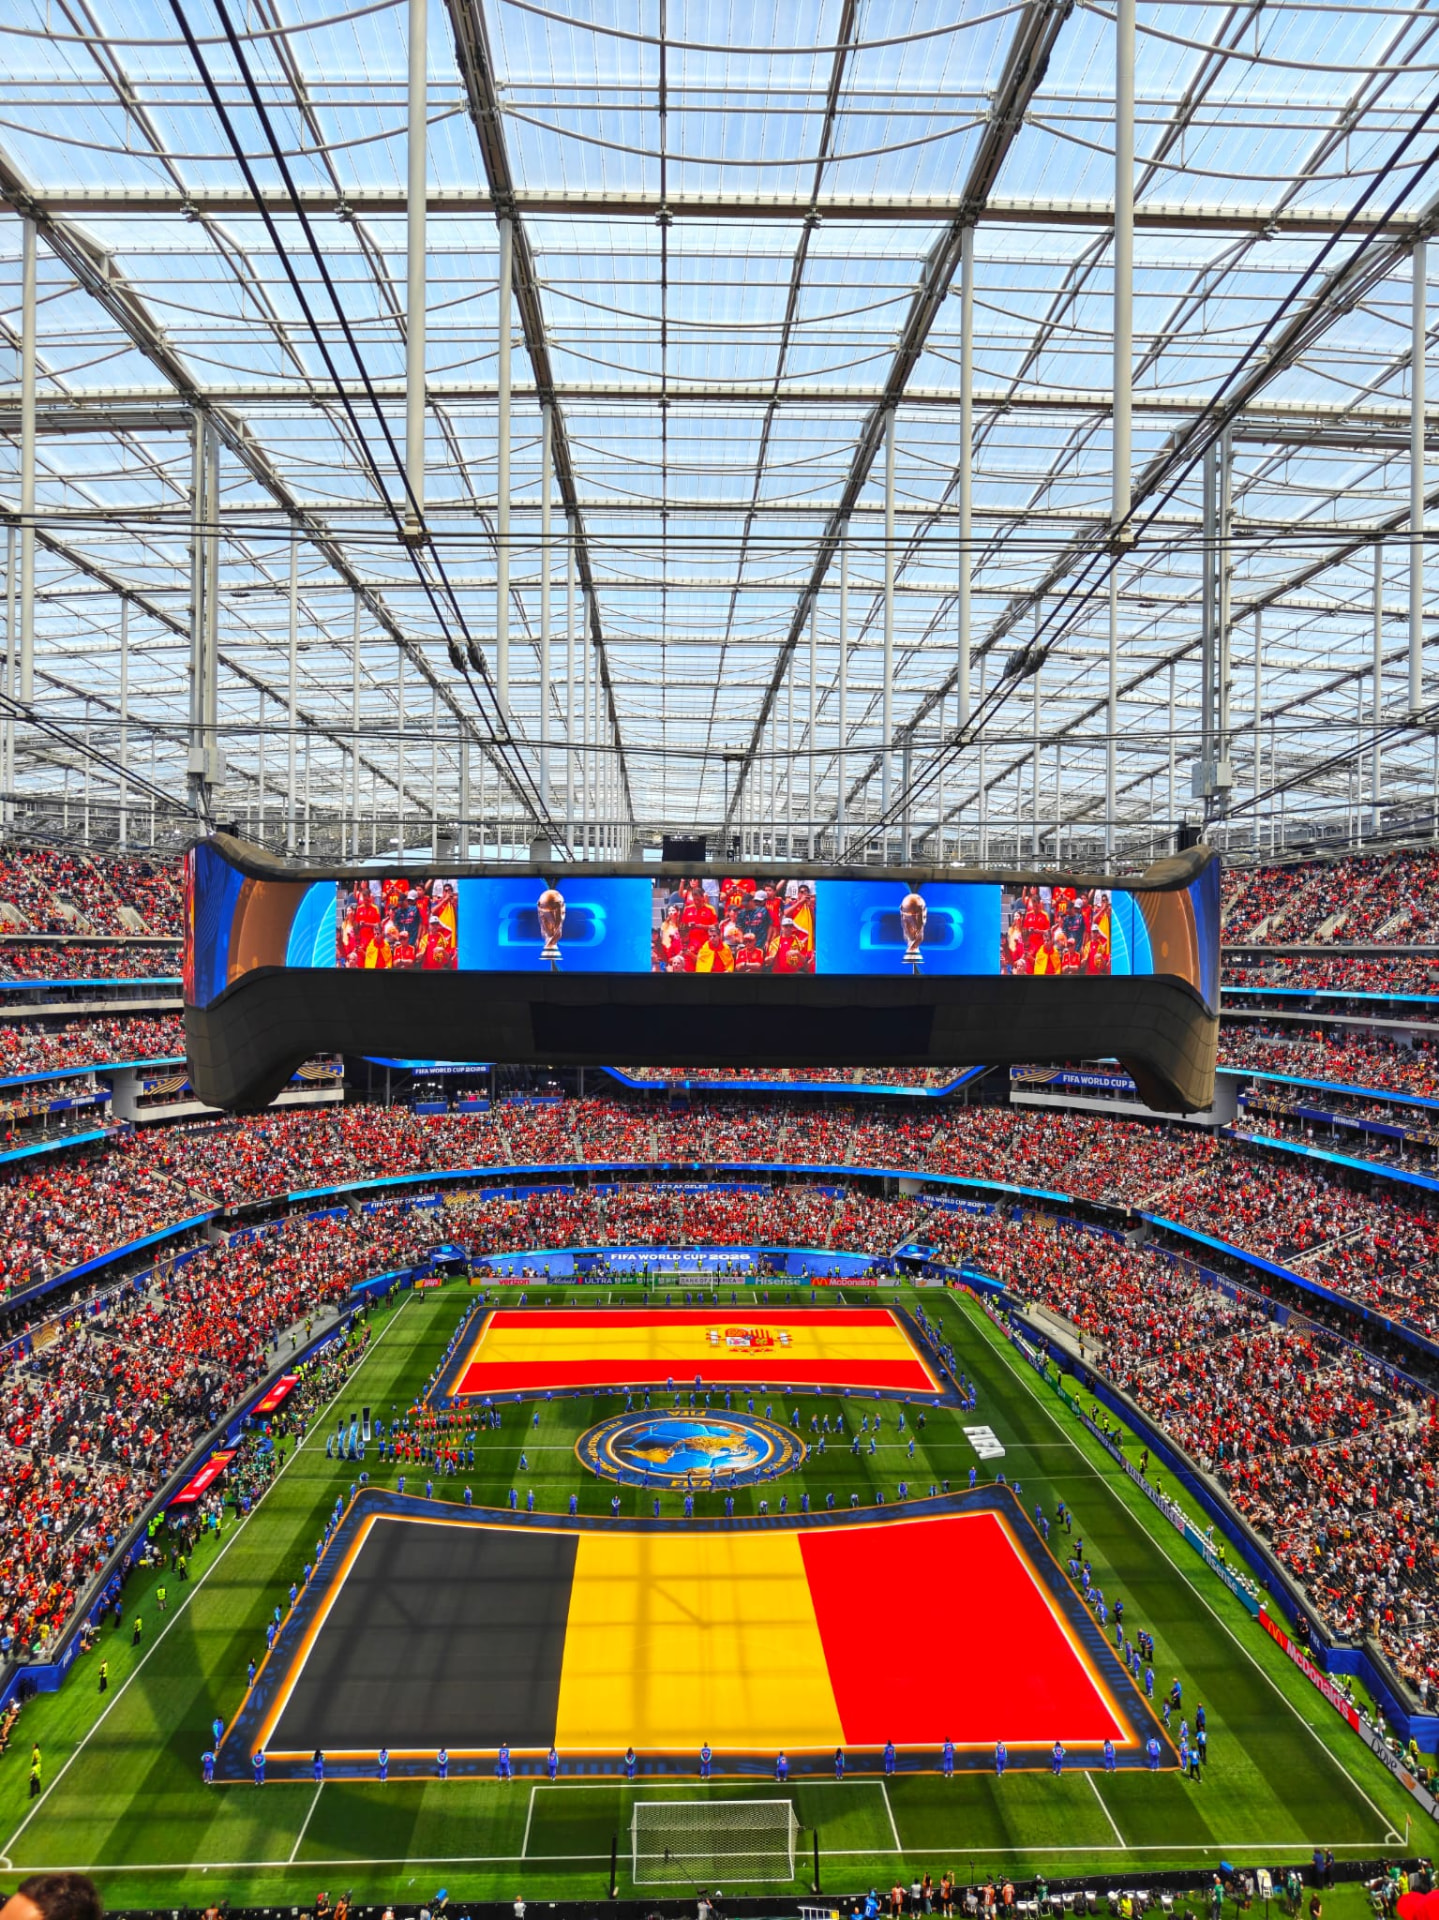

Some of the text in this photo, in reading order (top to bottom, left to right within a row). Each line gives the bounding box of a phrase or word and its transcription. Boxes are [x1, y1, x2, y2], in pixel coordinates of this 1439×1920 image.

[1063, 1074, 1080, 1083] FIFA
[1081, 1076, 1109, 1087] WORLD
[1111, 1079, 1127, 1088] CUP
[935, 1196, 955, 1204] WORLD
[955, 1198, 966, 1206] CUP
[498, 1277, 530, 1285] verizon
[755, 1276, 800, 1285] Hisense
[829, 1277, 876, 1286] McDonald's
[1202, 1545, 1238, 1595] Hisense
[1287, 1639, 1350, 1721] McDonald's
[1371, 1738, 1397, 1770] Dove
